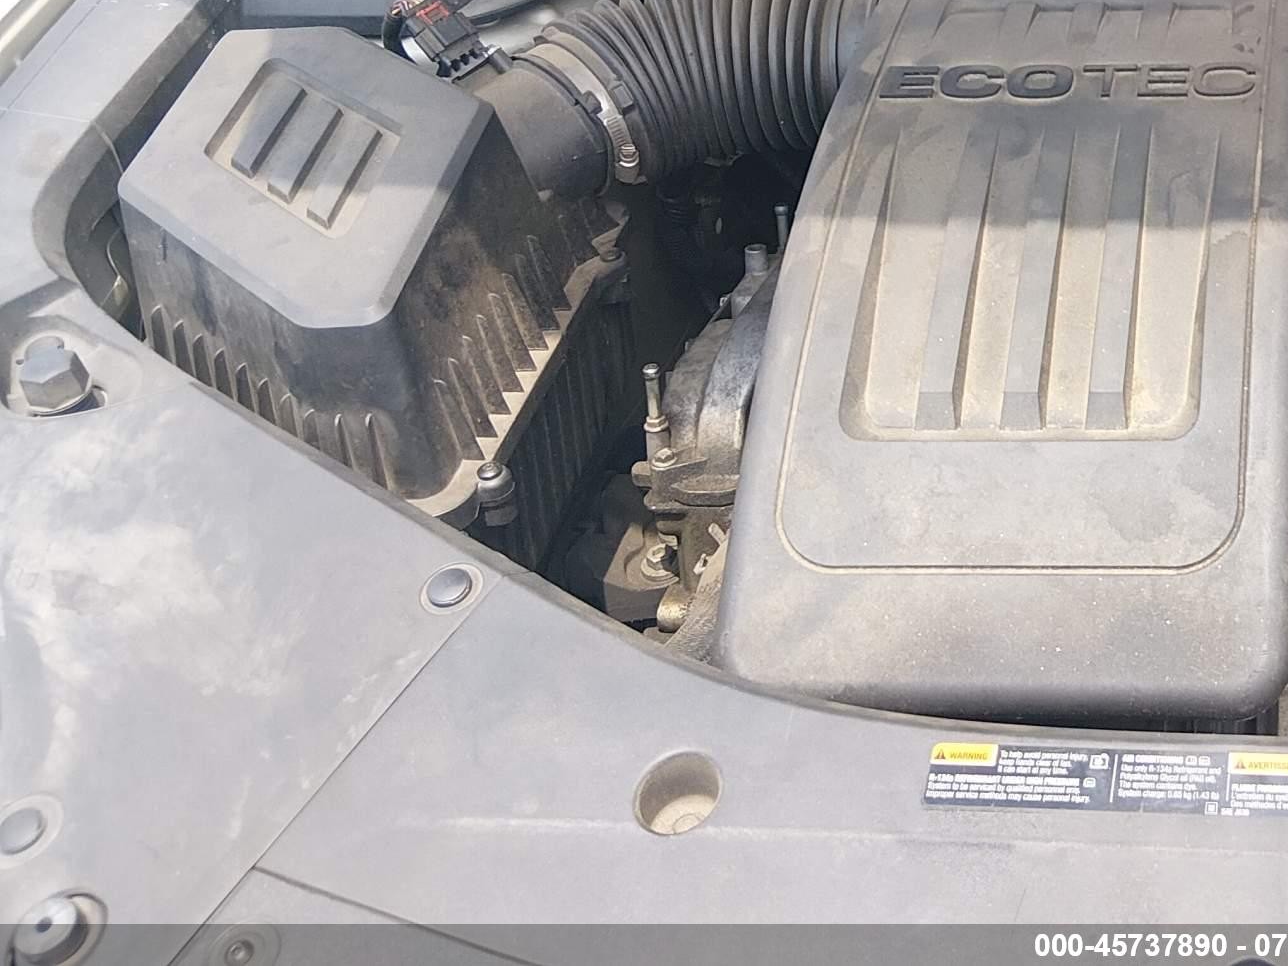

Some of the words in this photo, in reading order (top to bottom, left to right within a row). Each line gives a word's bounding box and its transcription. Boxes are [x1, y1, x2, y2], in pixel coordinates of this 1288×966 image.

[879, 64, 1217, 99] ECOTEC
[950, 752, 988, 760] WARNING
[1041, 752, 1068, 761] personal
[1134, 764, 1148, 774] only
[1148, 765, 1172, 774] R-134a
[1209, 767, 1221, 775] and
[1120, 780, 1132, 788] The
[1132, 782, 1155, 791] system
[1008, 794, 1021, 802] may
[1043, 794, 1070, 803] personal
[1118, 788, 1142, 798] System
[1183, 790, 1192, 800] kg
